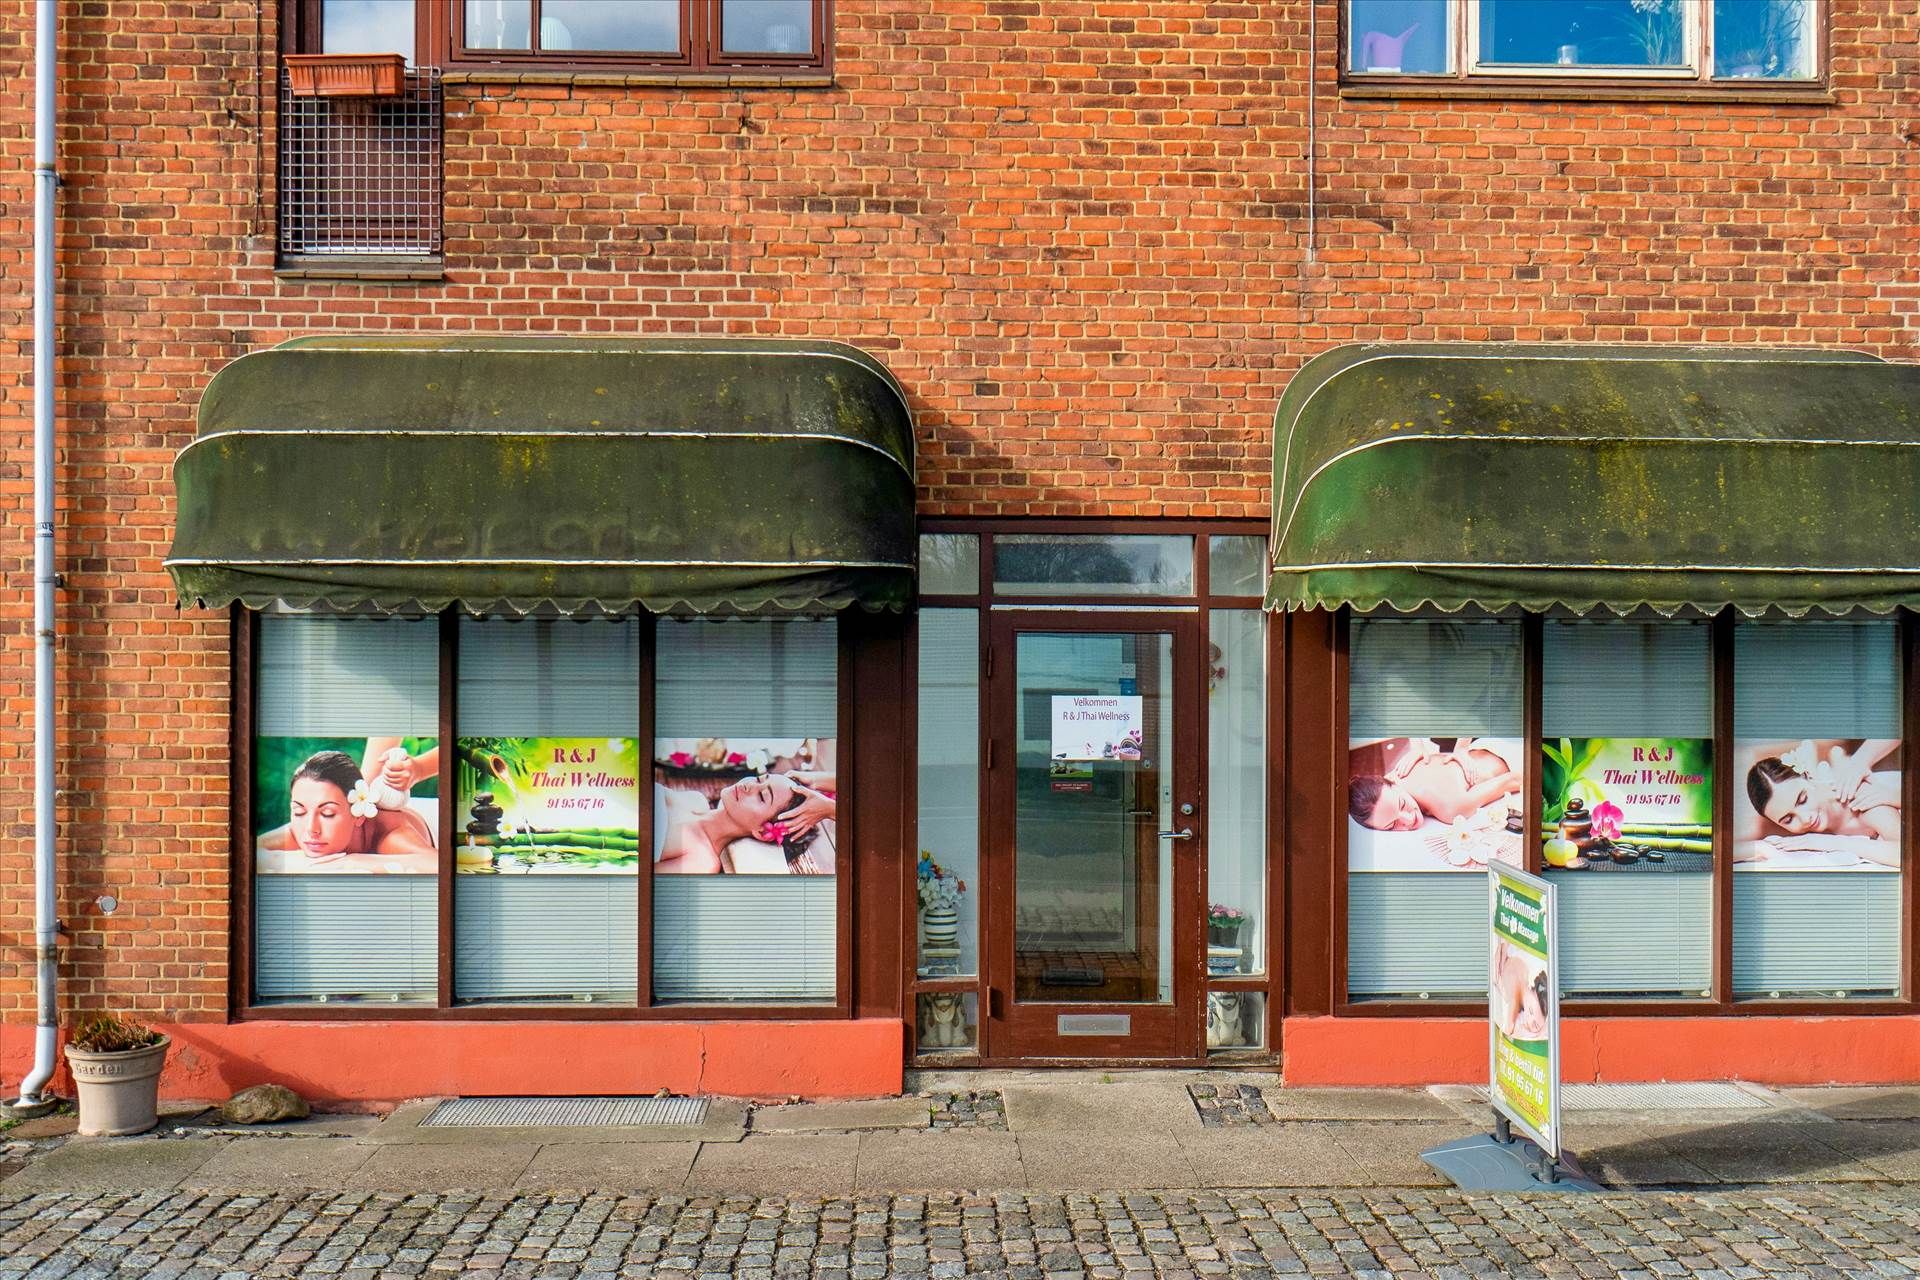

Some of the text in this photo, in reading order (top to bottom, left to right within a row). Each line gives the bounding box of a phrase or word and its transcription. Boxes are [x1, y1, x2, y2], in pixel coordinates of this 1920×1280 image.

[1073, 697, 1118, 707] Velkommen
[1062, 711, 1131, 721] R & J Thai Wellness
[554, 748, 596, 763] R & J
[1632, 747, 1674, 762] R & J
[532, 772, 636, 788] Thai Wellness
[1604, 769, 1704, 785] Thai Wellness
[1501, 889, 1538, 923] Velkommen
